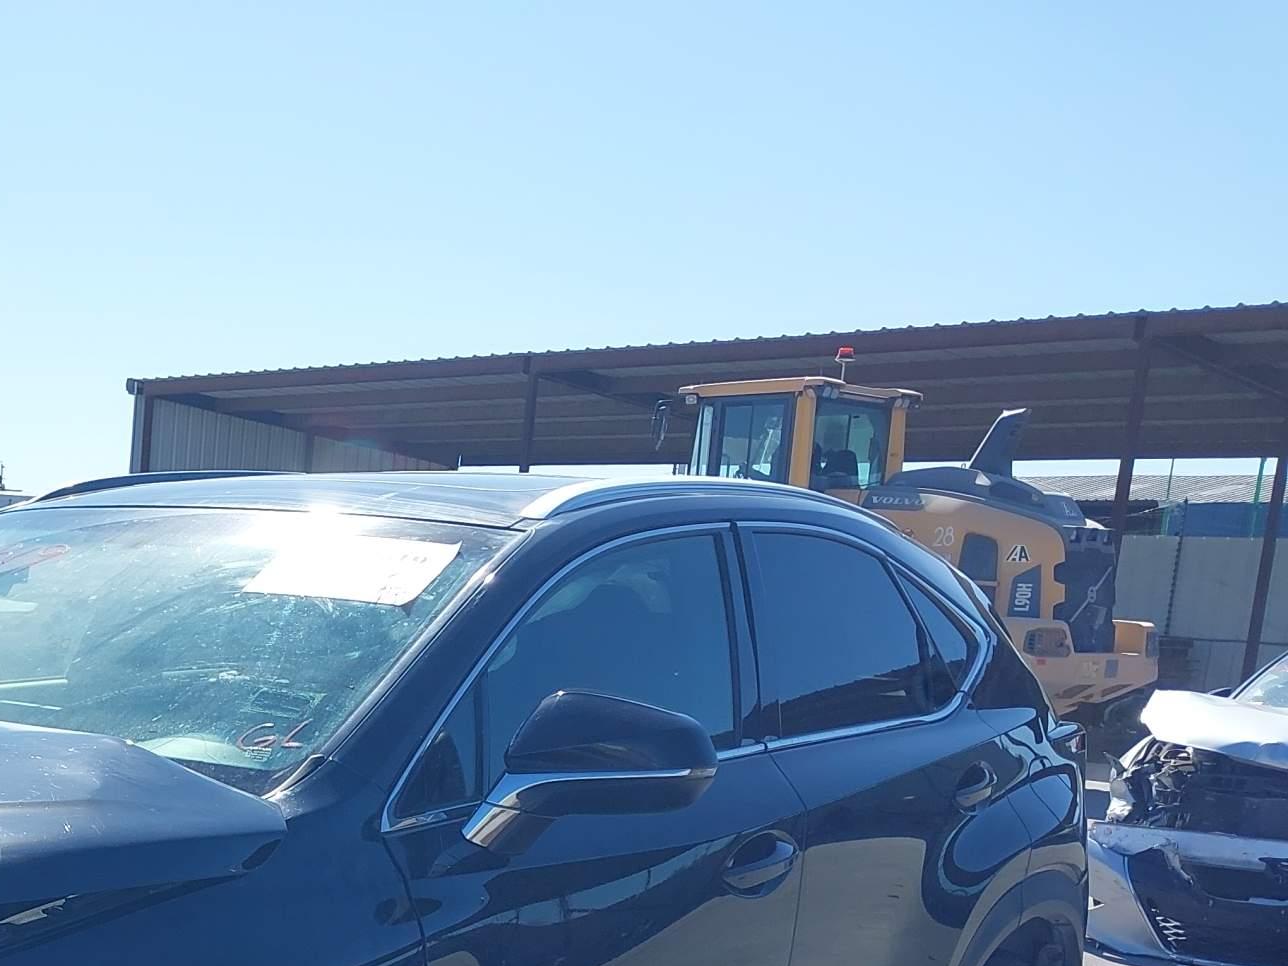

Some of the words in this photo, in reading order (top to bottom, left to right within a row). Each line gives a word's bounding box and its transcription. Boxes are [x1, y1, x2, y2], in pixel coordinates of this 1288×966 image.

[871, 494, 926, 505] VOLVO
[933, 526, 954, 547] 28
[1013, 583, 1033, 612] L90H
